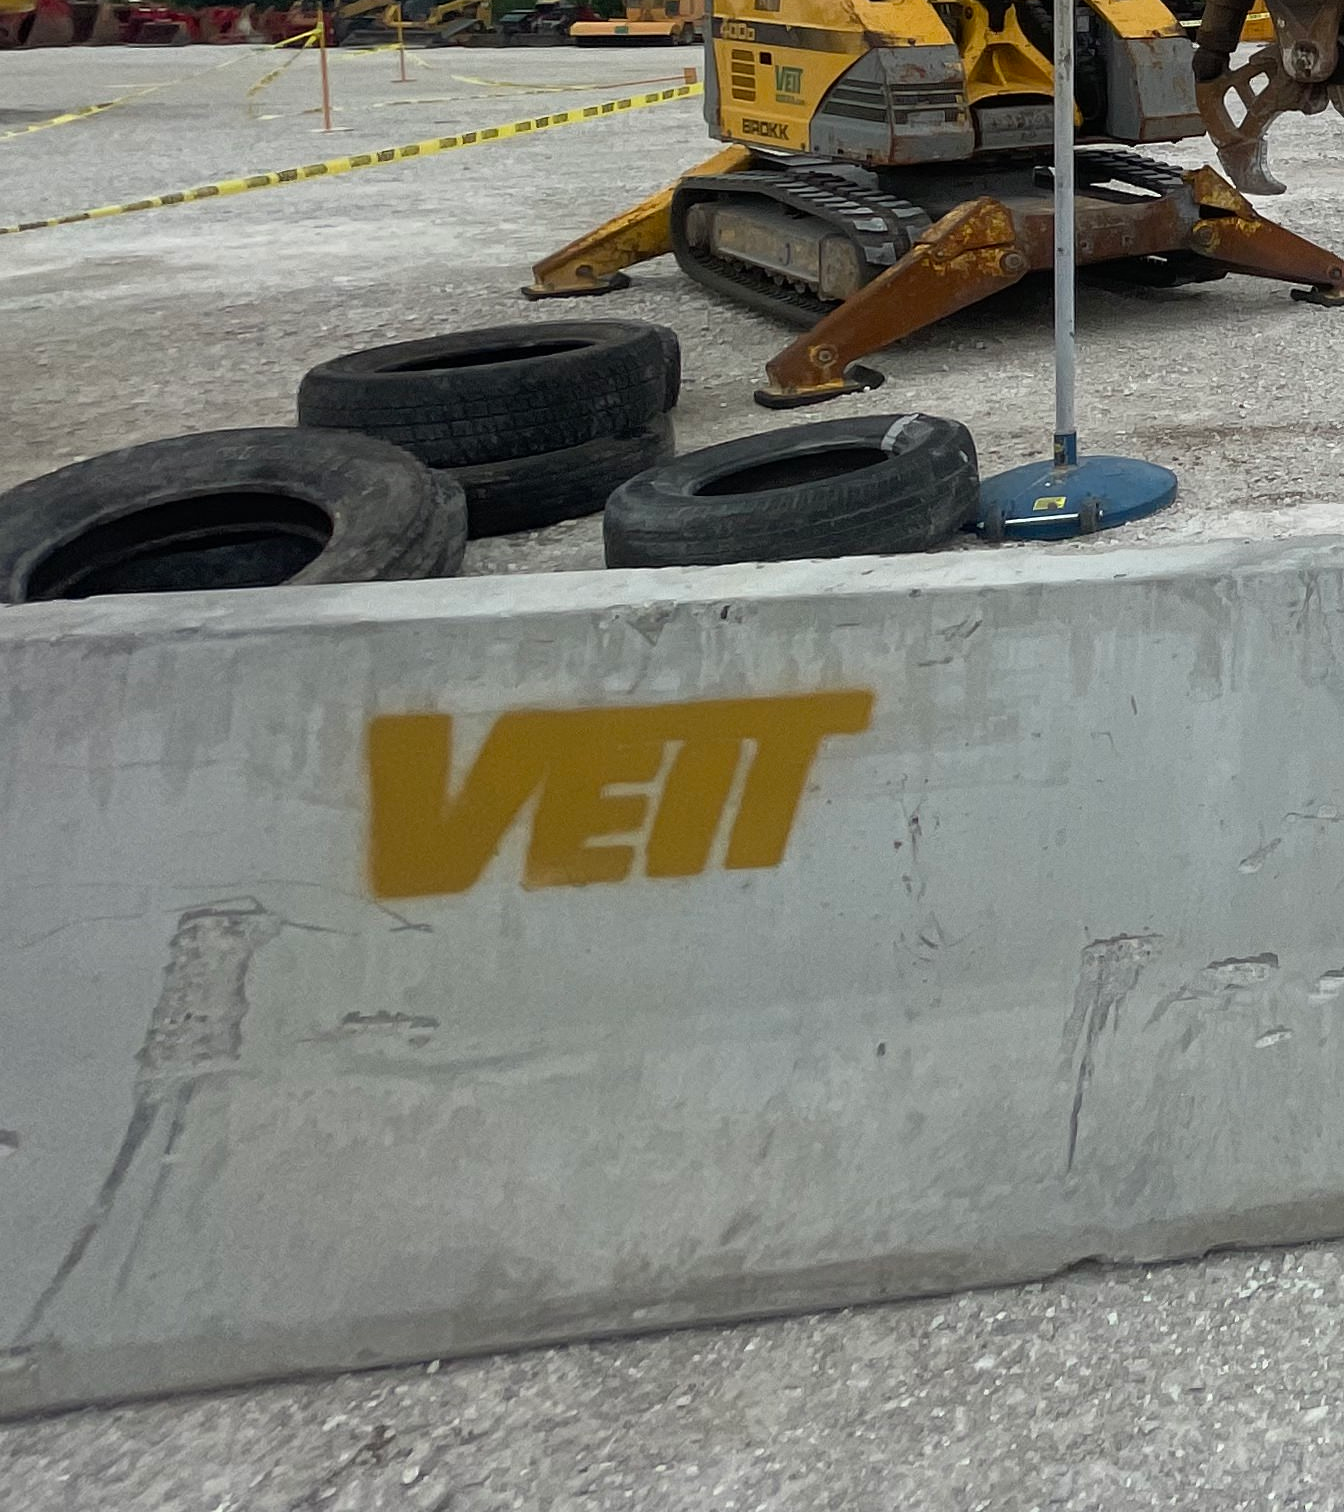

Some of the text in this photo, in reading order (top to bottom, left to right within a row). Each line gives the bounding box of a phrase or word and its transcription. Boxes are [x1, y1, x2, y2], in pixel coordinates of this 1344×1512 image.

[775, 65, 804, 94] VEIT
[742, 117, 789, 141] BROKK
[366, 689, 876, 900] VEIT
